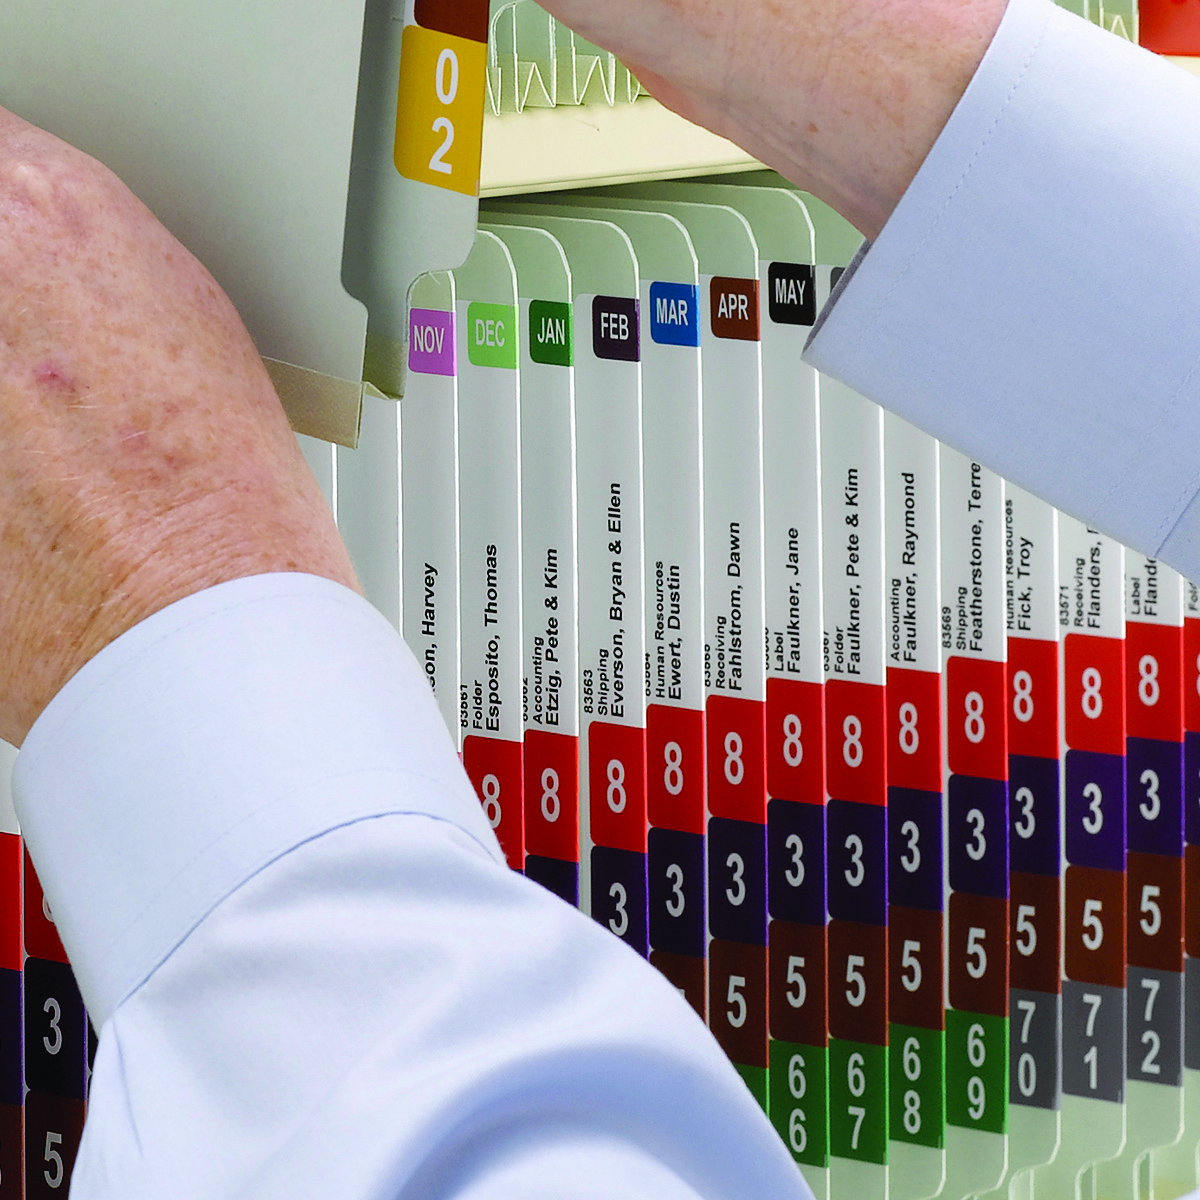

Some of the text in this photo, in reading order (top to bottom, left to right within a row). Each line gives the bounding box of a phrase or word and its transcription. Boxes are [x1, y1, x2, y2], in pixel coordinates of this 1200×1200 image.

[428, 117, 455, 174] 2
[476, 319, 505, 347] DEC
[601, 313, 628, 340] FEB
[718, 294, 748, 320] APR
[728, 523, 742, 690] Fahlstrom, Dawn
[786, 528, 801, 673] Faulkner, Jane
[902, 473, 918, 662] Faulkner, Raymond
[970, 520, 983, 651] Featherstone,
[1017, 537, 1033, 630] Fick, Troy
[484, 545, 502, 731] Esposito, Thomas
[545, 549, 561, 725] Etzig, Pete & Kim
[667, 566, 682, 699] Ewert, Dustin
[942, 607, 952, 648] 83569
[967, 1023, 987, 1067] 6
